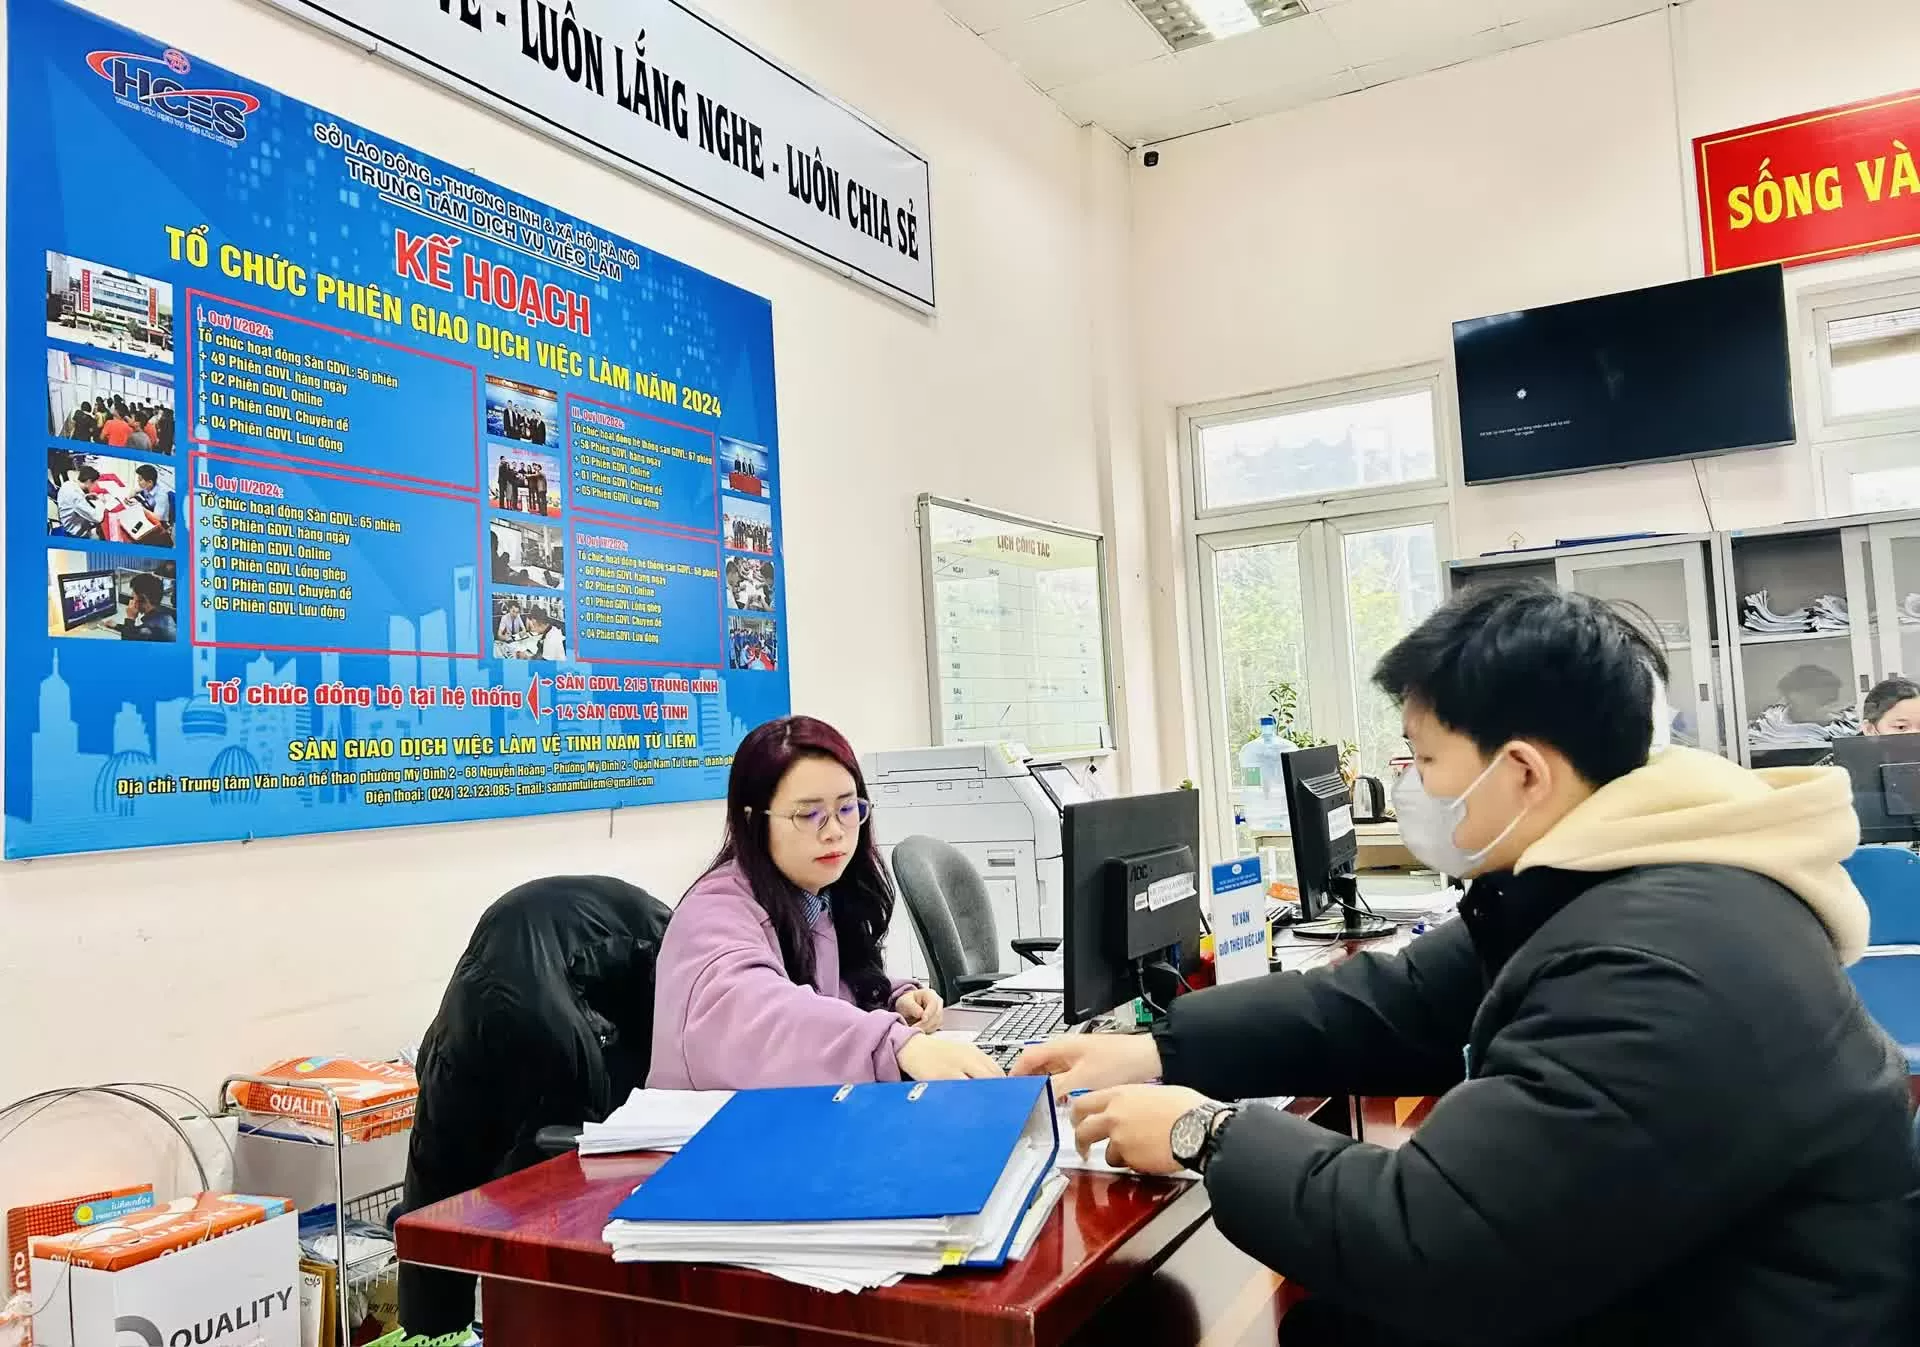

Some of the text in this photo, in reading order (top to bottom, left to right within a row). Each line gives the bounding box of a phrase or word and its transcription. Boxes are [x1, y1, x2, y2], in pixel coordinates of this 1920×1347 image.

[113, 57, 247, 141] HCES
[520, 0, 604, 97] LUÔN
[615, 28, 688, 142] LẮNG
[696, 92, 764, 180] NGHE
[786, 144, 840, 220] LUÔN
[846, 178, 894, 249] CHIA
[897, 198, 919, 262] SẺ
[315, 124, 345, 147] SỞ
[342, 135, 380, 163] LAO
[383, 152, 431, 184] ĐỘNG
[443, 176, 508, 214] THƯƠNG
[508, 203, 541, 229] BINH
[543, 219, 553, 234] &
[576, 230, 598, 255] HỘI
[599, 241, 617, 260] HÀ
[616, 248, 639, 268] NỘI
[1728, 139, 1920, 230] SỐNG VÀ
[346, 158, 621, 281] TRUNG TÂM DỊCH VỤ VIỆC LÀM
[395, 229, 592, 337] KẾ HOẠCH
[165, 224, 209, 268] TỔ
[220, 244, 307, 297] CHỨC
[317, 273, 402, 325] PHIÊN
[410, 303, 469, 344] GIAO
[476, 322, 530, 362] DỊCH
[536, 341, 583, 378] VIỆC
[588, 356, 630, 391] LÀM
[635, 371, 677, 405] NĂM
[682, 387, 722, 418] 2024
[209, 313, 273, 340] Quý I/2024:
[210, 351, 226, 366] 49
[228, 355, 262, 375] Phiên
[264, 364, 292, 382] GDVL
[215, 334, 244, 351] chức
[247, 340, 272, 358] hoạt
[274, 348, 302, 366] động
[326, 361, 355, 378] GDVL:
[357, 367, 370, 381] 56
[371, 372, 398, 387] phiên
[210, 371, 323, 407] 02 Phiên GDVL Online
[211, 392, 334, 429] 01 Phiên GDVL Chuyên
[211, 415, 226, 430] 04
[229, 418, 263, 437] Phiên
[265, 425, 293, 443] GDVL
[200, 473, 284, 498] II. Quý II/2024:
[213, 515, 228, 529] 55
[231, 518, 265, 534] Phiên
[267, 522, 294, 538] GDVL
[218, 497, 247, 512] chức
[250, 500, 275, 516] hoạt
[277, 504, 304, 521] động
[329, 511, 358, 527] GDVL:
[359, 516, 372, 529] 65
[374, 519, 401, 532] phiên
[213, 535, 331, 561] 03 Phiên GDVL Online
[214, 596, 229, 611] 05
[232, 598, 266, 613] Phiên
[268, 600, 296, 615] GDVL
[207, 678, 522, 709] Tổ chức đồng bộ tại hệ thống
[556, 675, 718, 693] SÀN GDVL 215 TRUNG KÍNH
[558, 704, 689, 723] 14 SÀN GDVL VỆ TINH
[289, 733, 697, 761] SÀN GIAO DỊCH VIỆC LÀM VỆ TINH NAM TỪ LIÊM
[117, 779, 144, 797] Địa
[180, 777, 220, 792] Trung
[224, 776, 250, 790] tâm
[254, 775, 278, 788] Văn
[282, 774, 305, 787] hoá
[331, 771, 357, 785] thao
[360, 770, 401, 784] phường
[449, 767, 456, 779] 2
[465, 766, 478, 778] 68
[365, 791, 391, 804] Điện
[394, 786, 425, 803] thoại:
[428, 787, 454, 801] (024)
[516, 782, 545, 795] Email:
[269, 1093, 333, 1117] QUALITY
[169, 1286, 293, 1347] QUALITY
